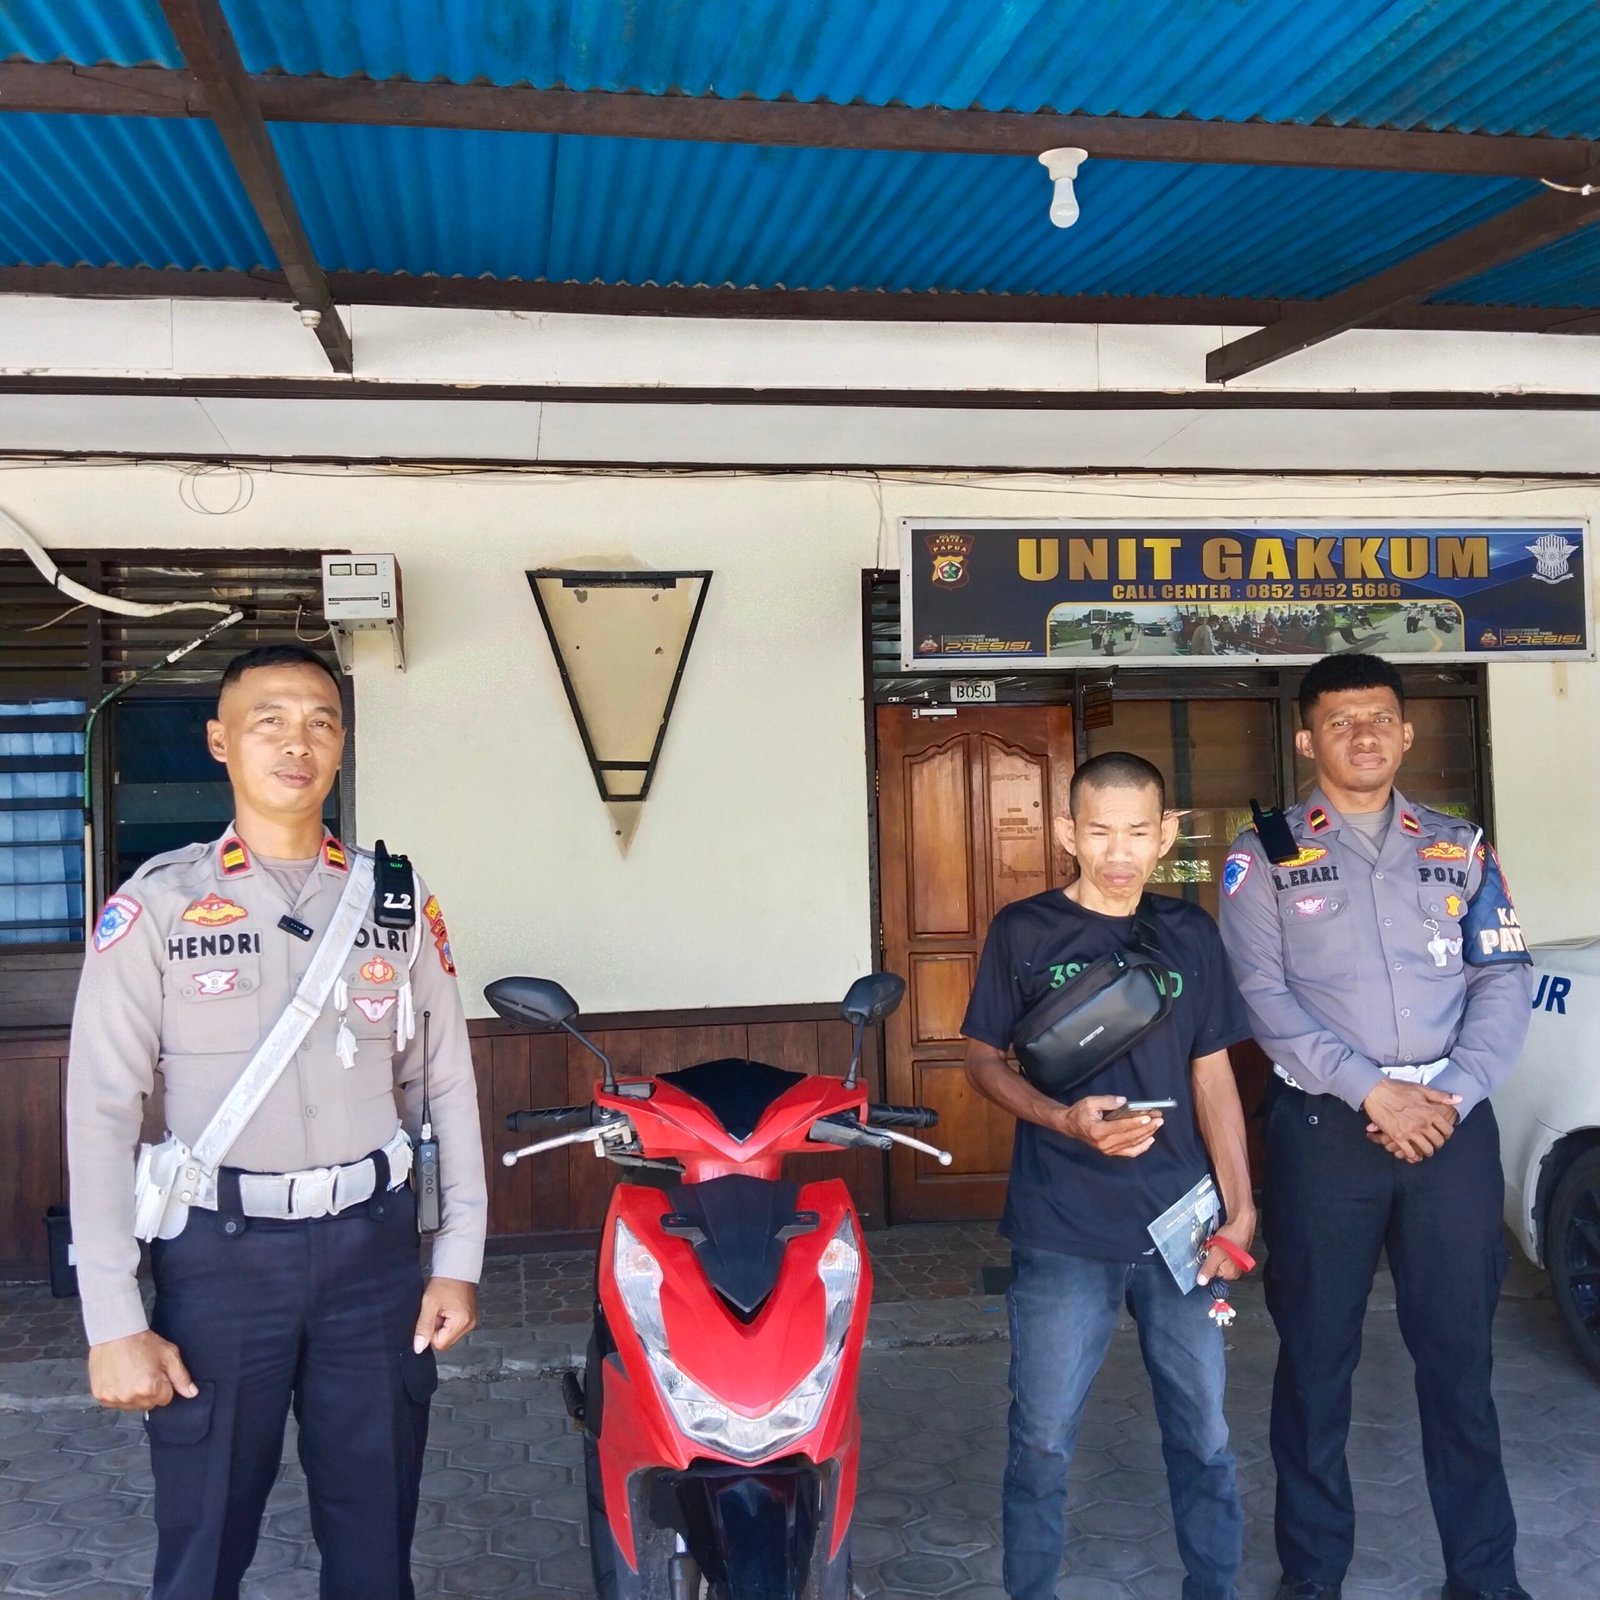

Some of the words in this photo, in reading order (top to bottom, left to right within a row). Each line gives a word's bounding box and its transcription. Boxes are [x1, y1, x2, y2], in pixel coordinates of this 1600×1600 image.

[1018, 537, 1182, 582] UNIT
[1202, 536, 1490, 582] GAKKUM
[1112, 584, 1157, 600] CALL
[1161, 584, 1232, 600] CENTER
[1246, 583, 1294, 599] 0852
[1299, 583, 1347, 598] 5452
[1351, 582, 1401, 598] 5686
[945, 641, 1031, 651] PRESISI
[1503, 634, 1582, 644] PRESISI
[1418, 867, 1467, 889] POLR
[168, 932, 261, 961] HENDRI
[353, 927, 408, 953] OLRI
[1480, 927, 1529, 956] PAT
